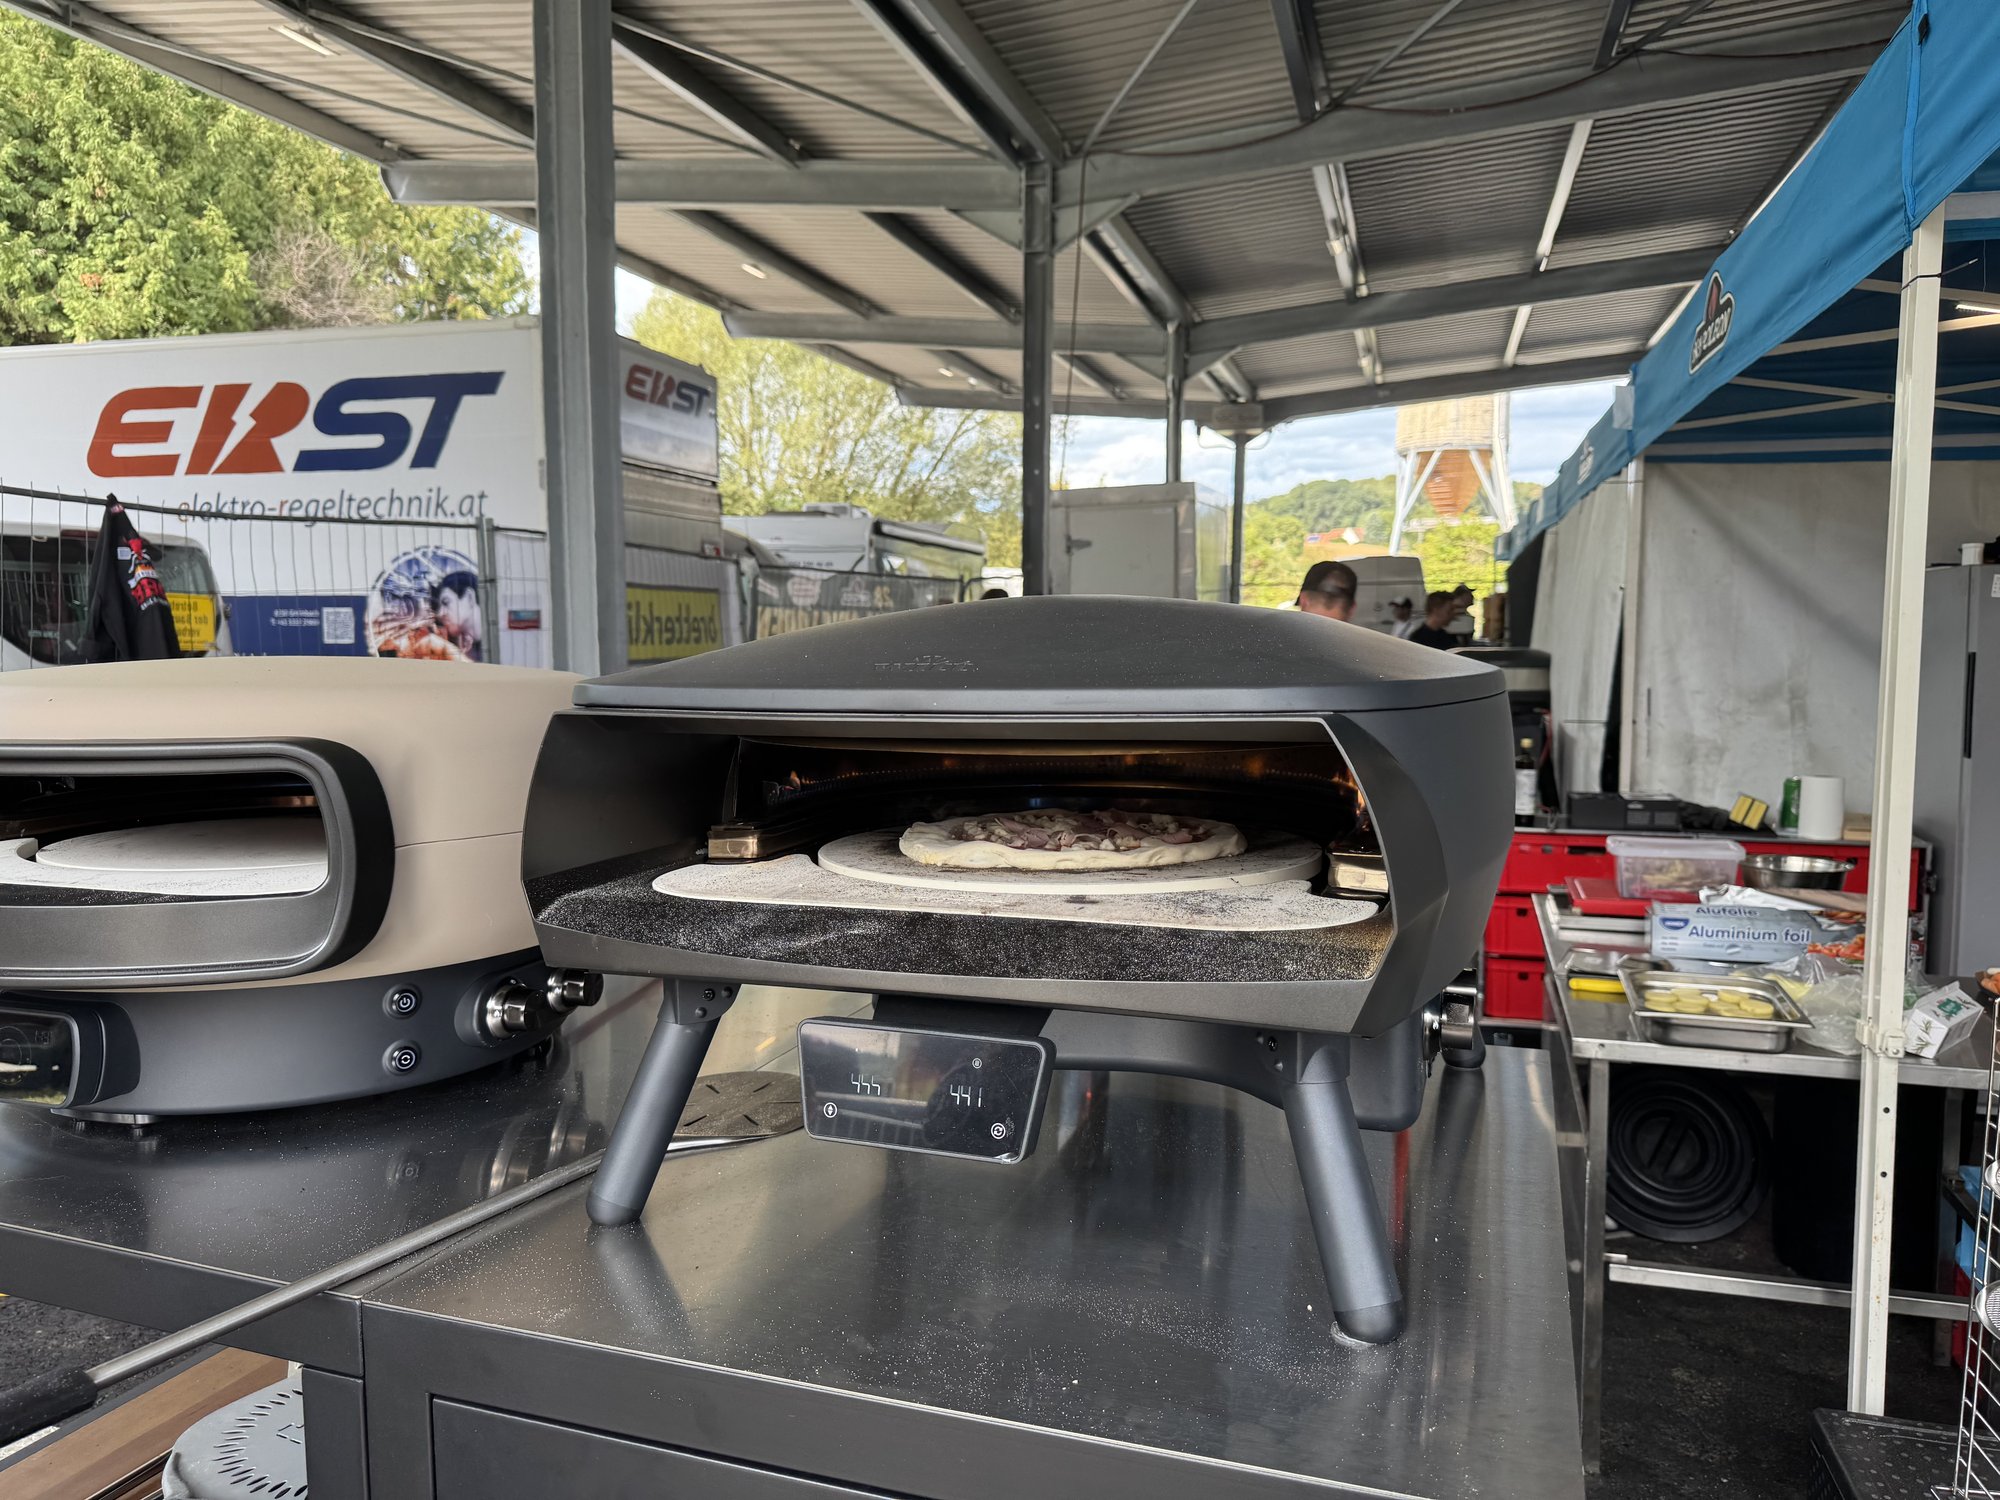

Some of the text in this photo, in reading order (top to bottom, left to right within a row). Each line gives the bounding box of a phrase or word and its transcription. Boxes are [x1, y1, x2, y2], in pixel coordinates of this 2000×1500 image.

[625, 363, 711, 418] ERST
[87, 371, 505, 477] ERST
[177, 487, 489, 527] elektro-regeltechnik.at
[1695, 905, 1760, 917] Alufolie
[1688, 925, 1811, 944] Aluminium foil
[949, 1083, 983, 1108] 441
